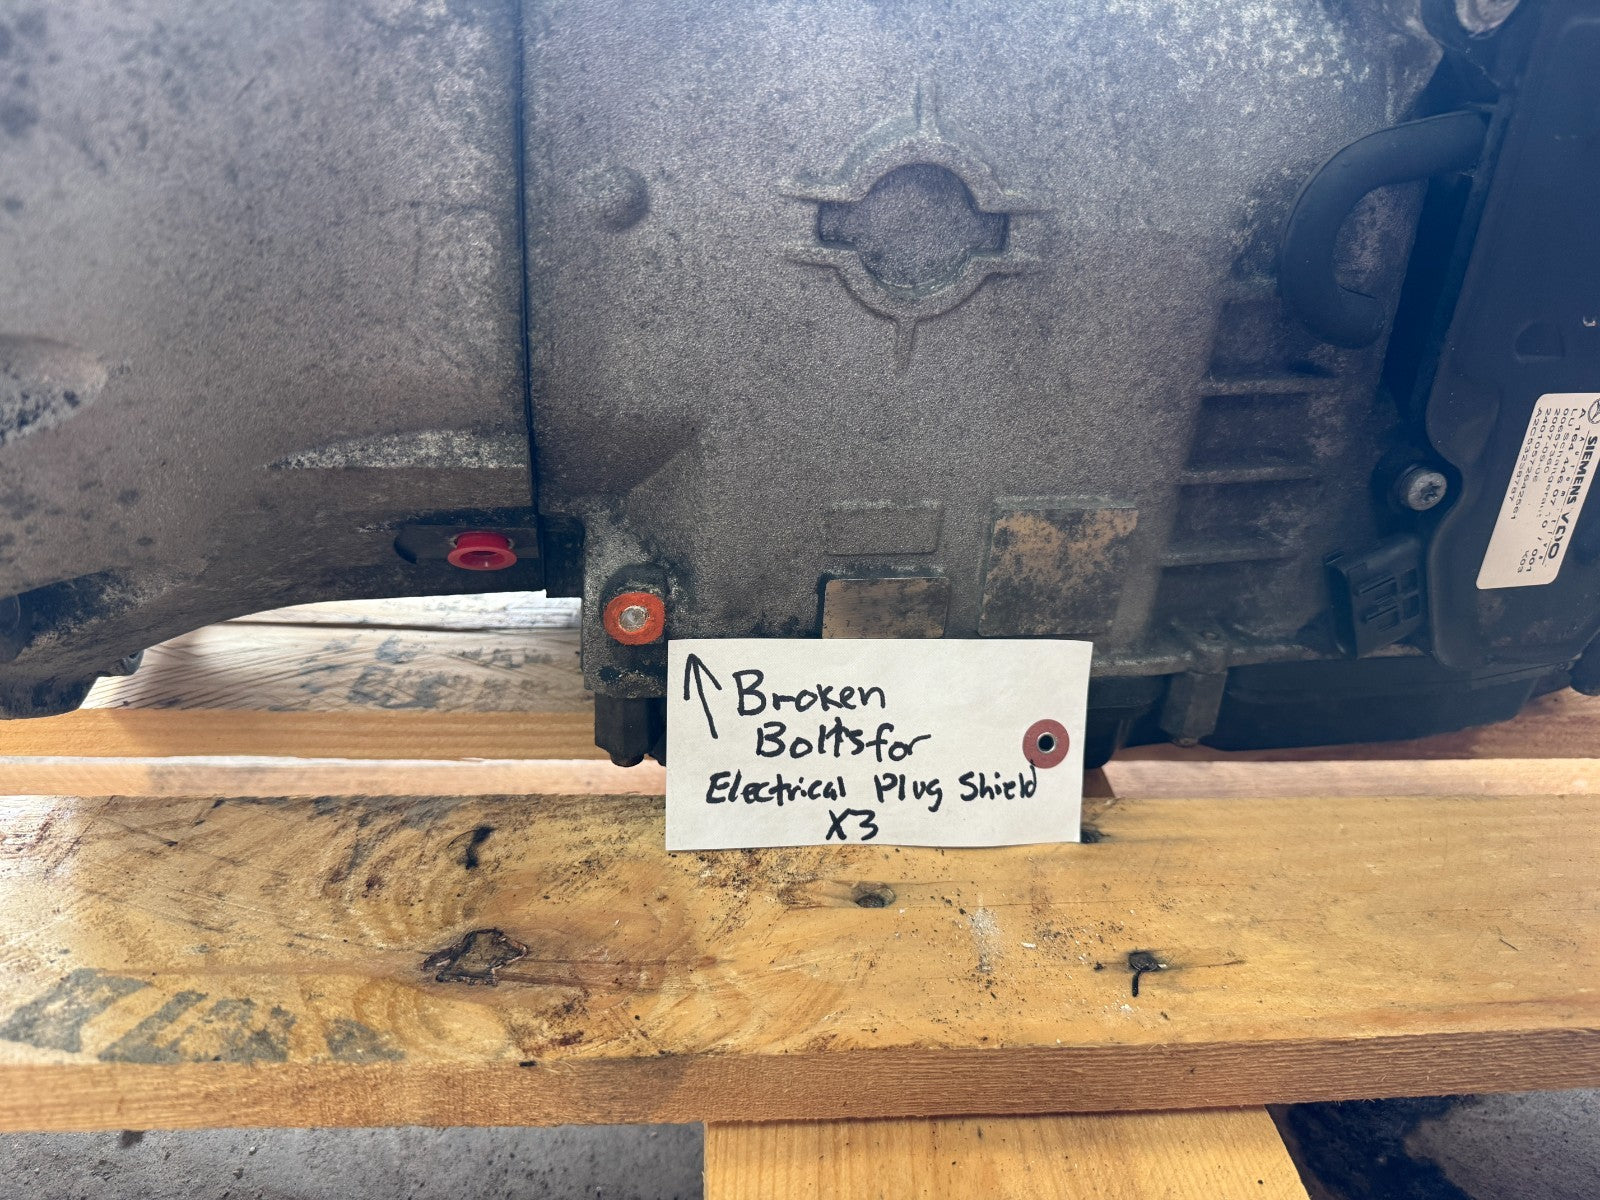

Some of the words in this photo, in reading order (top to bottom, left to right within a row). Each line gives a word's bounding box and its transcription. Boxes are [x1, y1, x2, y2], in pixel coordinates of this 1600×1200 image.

[1578, 408, 1587, 419] A
[1568, 425, 1581, 451] 164
[1566, 435, 1599, 505] SIEMENS
[1538, 436, 1586, 560] Automtive
[1550, 489, 1559, 507] 07
[1547, 511, 1570, 560] VDO
[1526, 548, 1538, 572] 001
[732, 669, 887, 716] Broken
[866, 722, 932, 762] for
[705, 768, 847, 807] Electrical
[873, 771, 944, 812] Plug
[958, 758, 1039, 802] Shield
